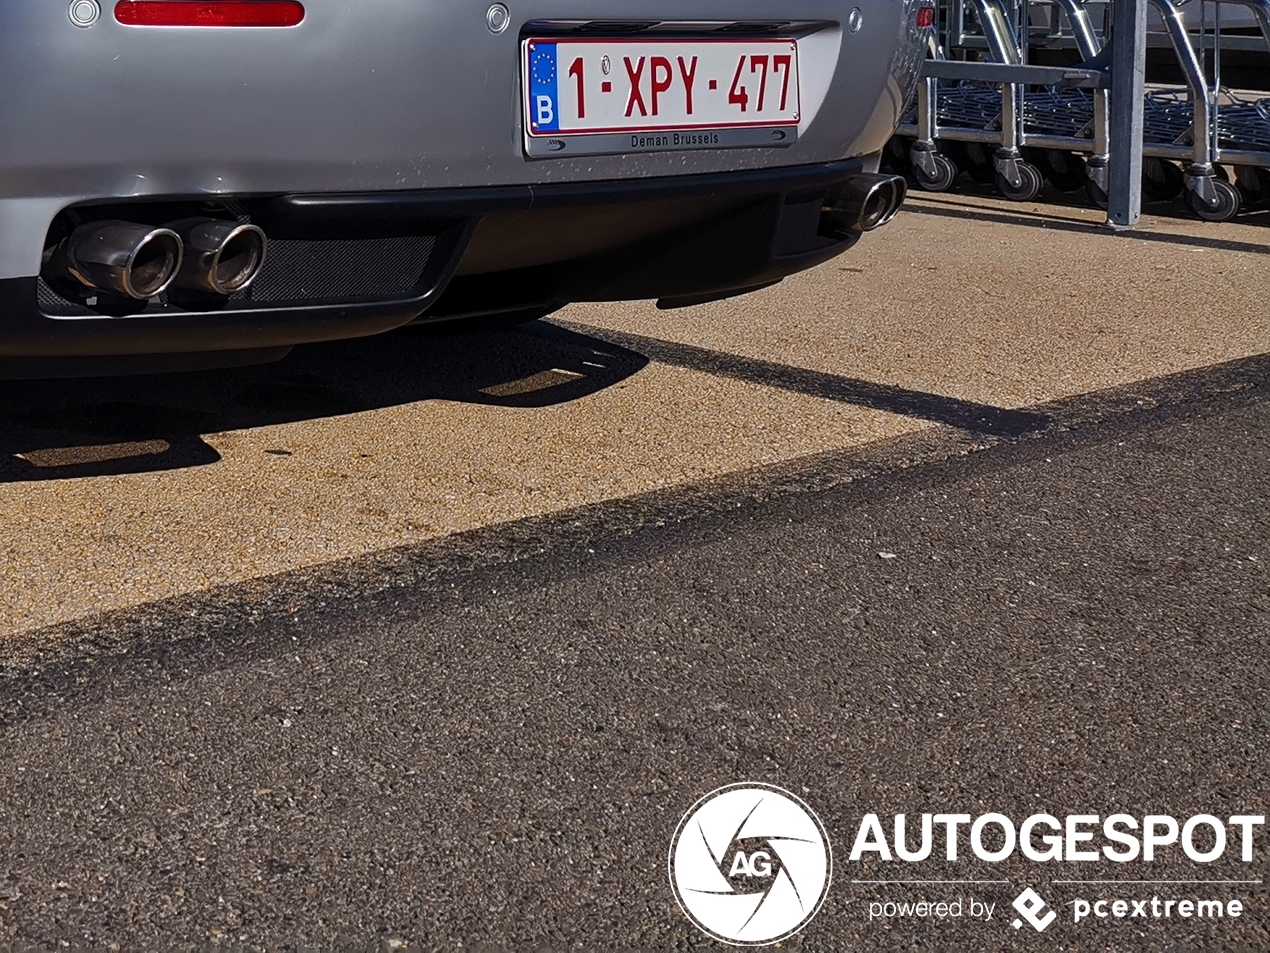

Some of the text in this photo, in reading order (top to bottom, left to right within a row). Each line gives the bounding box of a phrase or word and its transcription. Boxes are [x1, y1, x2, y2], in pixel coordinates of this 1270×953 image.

[536, 95, 554, 125] B
[631, 132, 719, 148] Deman Brussels
